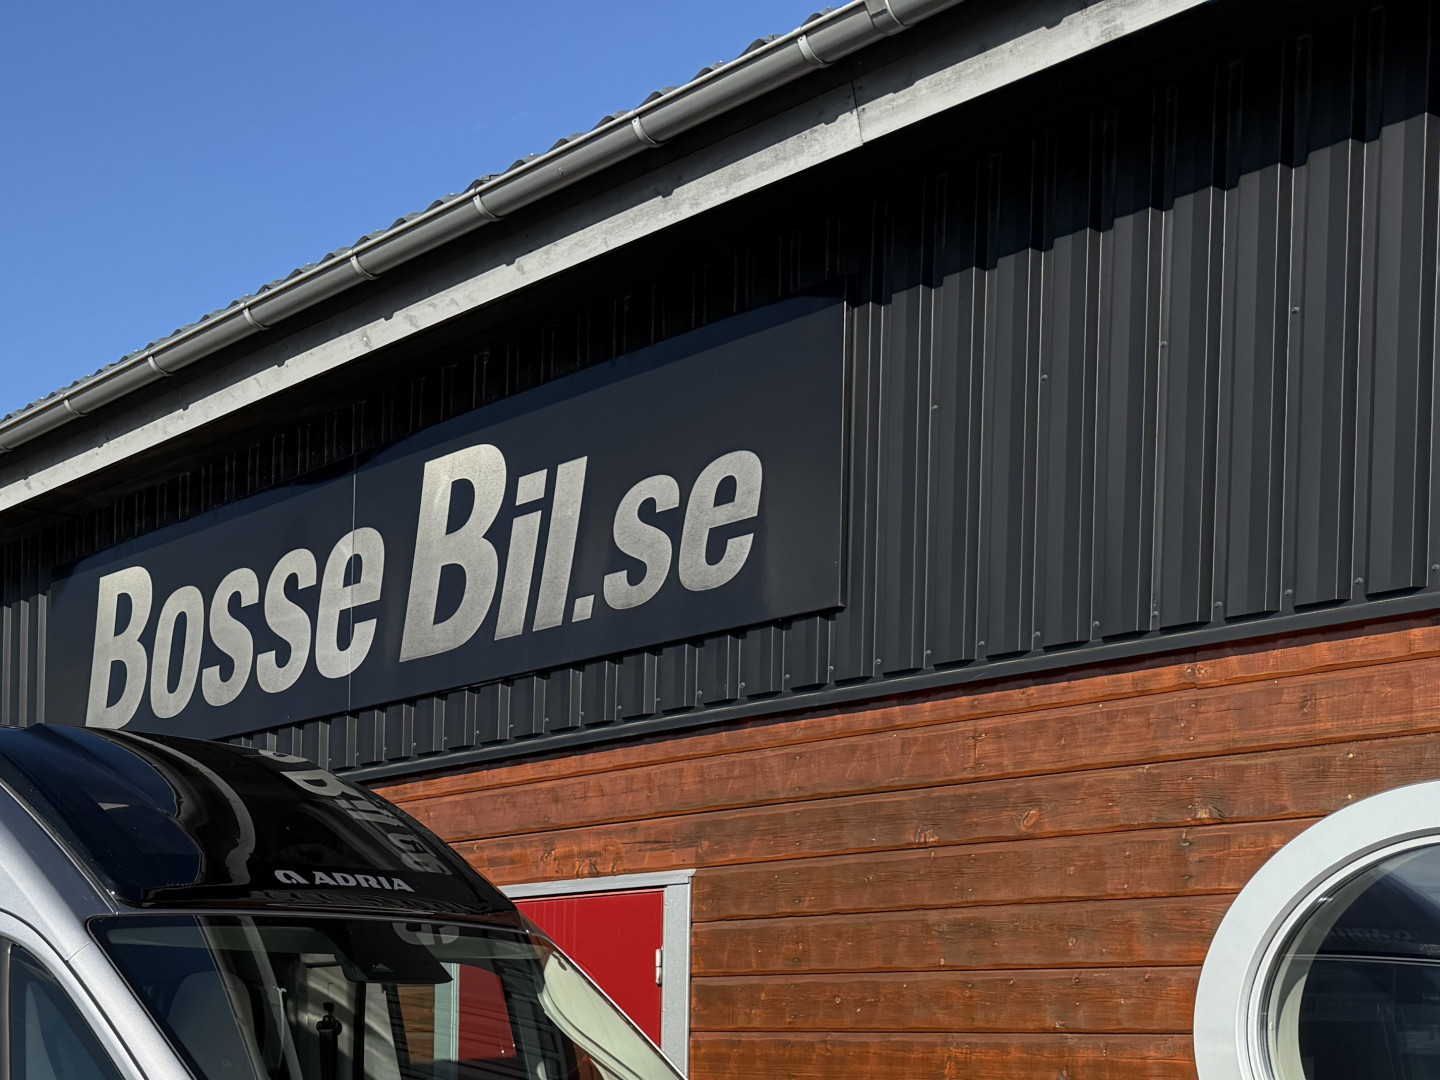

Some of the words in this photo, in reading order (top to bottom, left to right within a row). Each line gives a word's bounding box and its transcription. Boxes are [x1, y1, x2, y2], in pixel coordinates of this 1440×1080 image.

[85, 526, 386, 730] Bosse
[399, 443, 763, 662] Bil.se
[312, 870, 416, 893] ADRIA
